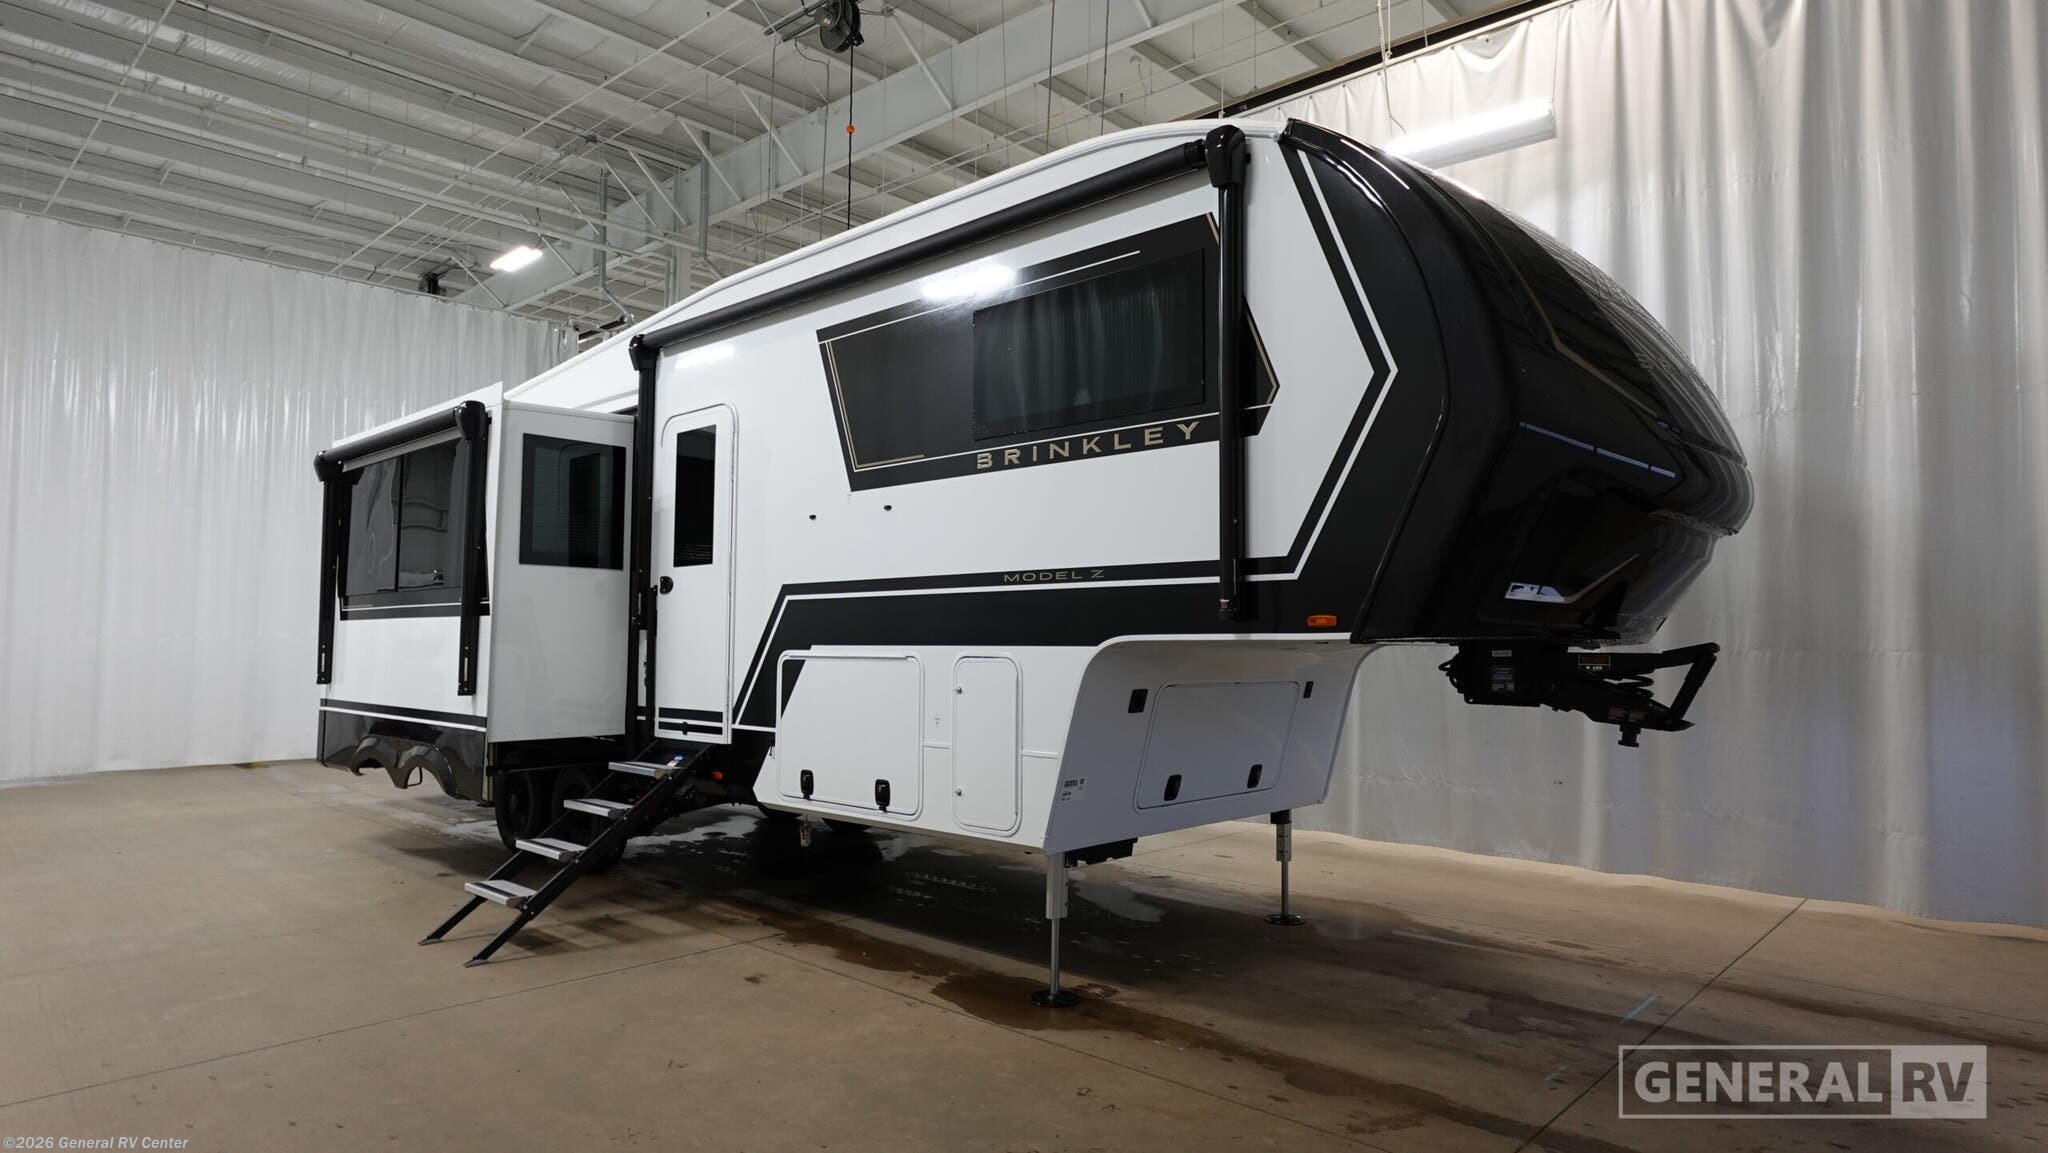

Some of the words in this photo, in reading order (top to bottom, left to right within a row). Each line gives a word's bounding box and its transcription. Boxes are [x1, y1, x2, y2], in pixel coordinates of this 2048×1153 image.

[977, 421, 1199, 469] BRINKLEY
[1004, 570, 1083, 583] MODEL
[1090, 569, 1105, 579] Z
